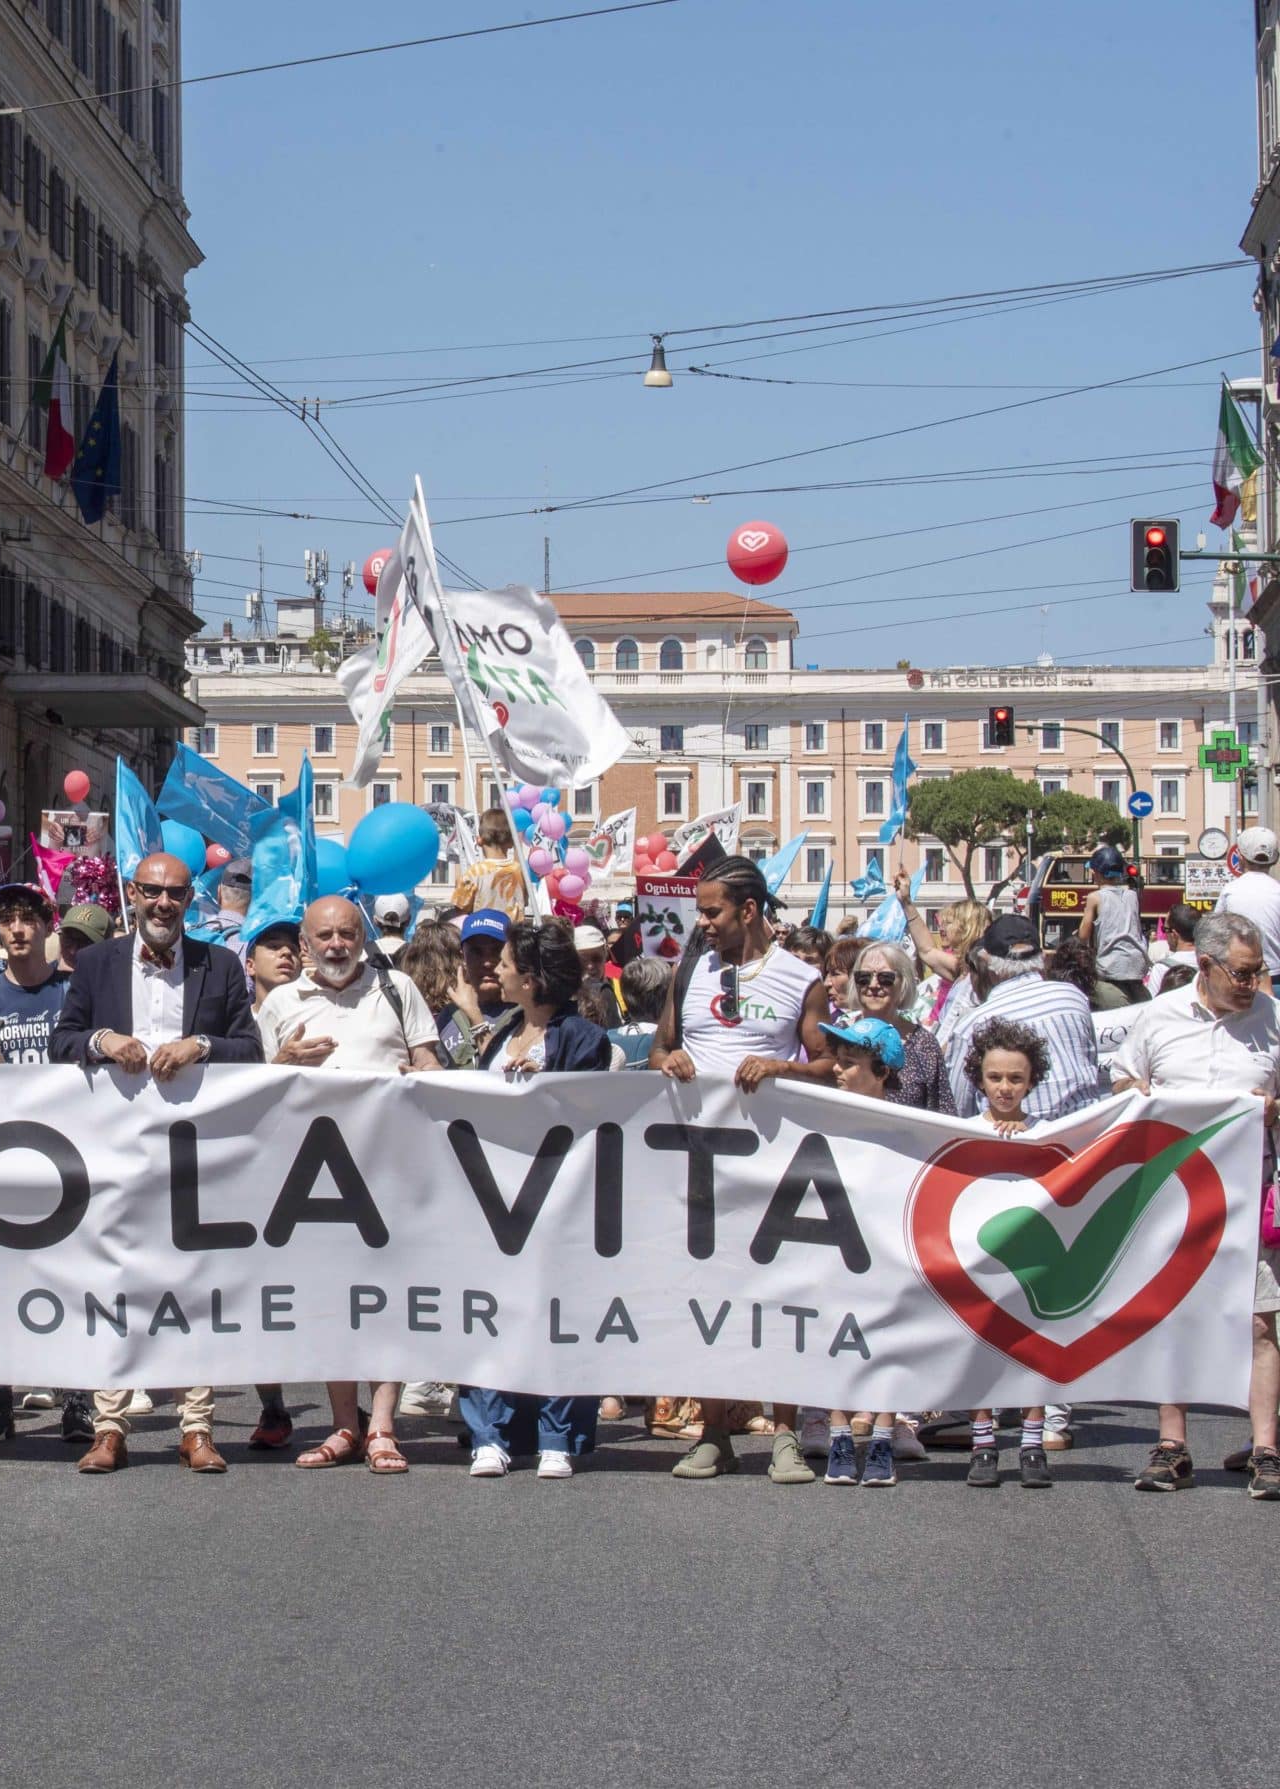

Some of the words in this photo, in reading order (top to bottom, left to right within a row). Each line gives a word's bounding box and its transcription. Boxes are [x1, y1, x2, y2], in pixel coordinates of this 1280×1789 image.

[645, 882, 670, 896] Ogni
[670, 884, 692, 895] vita
[1051, 891, 1066, 899] BIG
[2, 1037, 48, 1050] OOTBALL
[168, 1111, 390, 1252] LA
[446, 1118, 872, 1274] VITA
[350, 1285, 498, 1337] PER
[550, 1297, 639, 1344] LA
[688, 1298, 872, 1361] VITA
